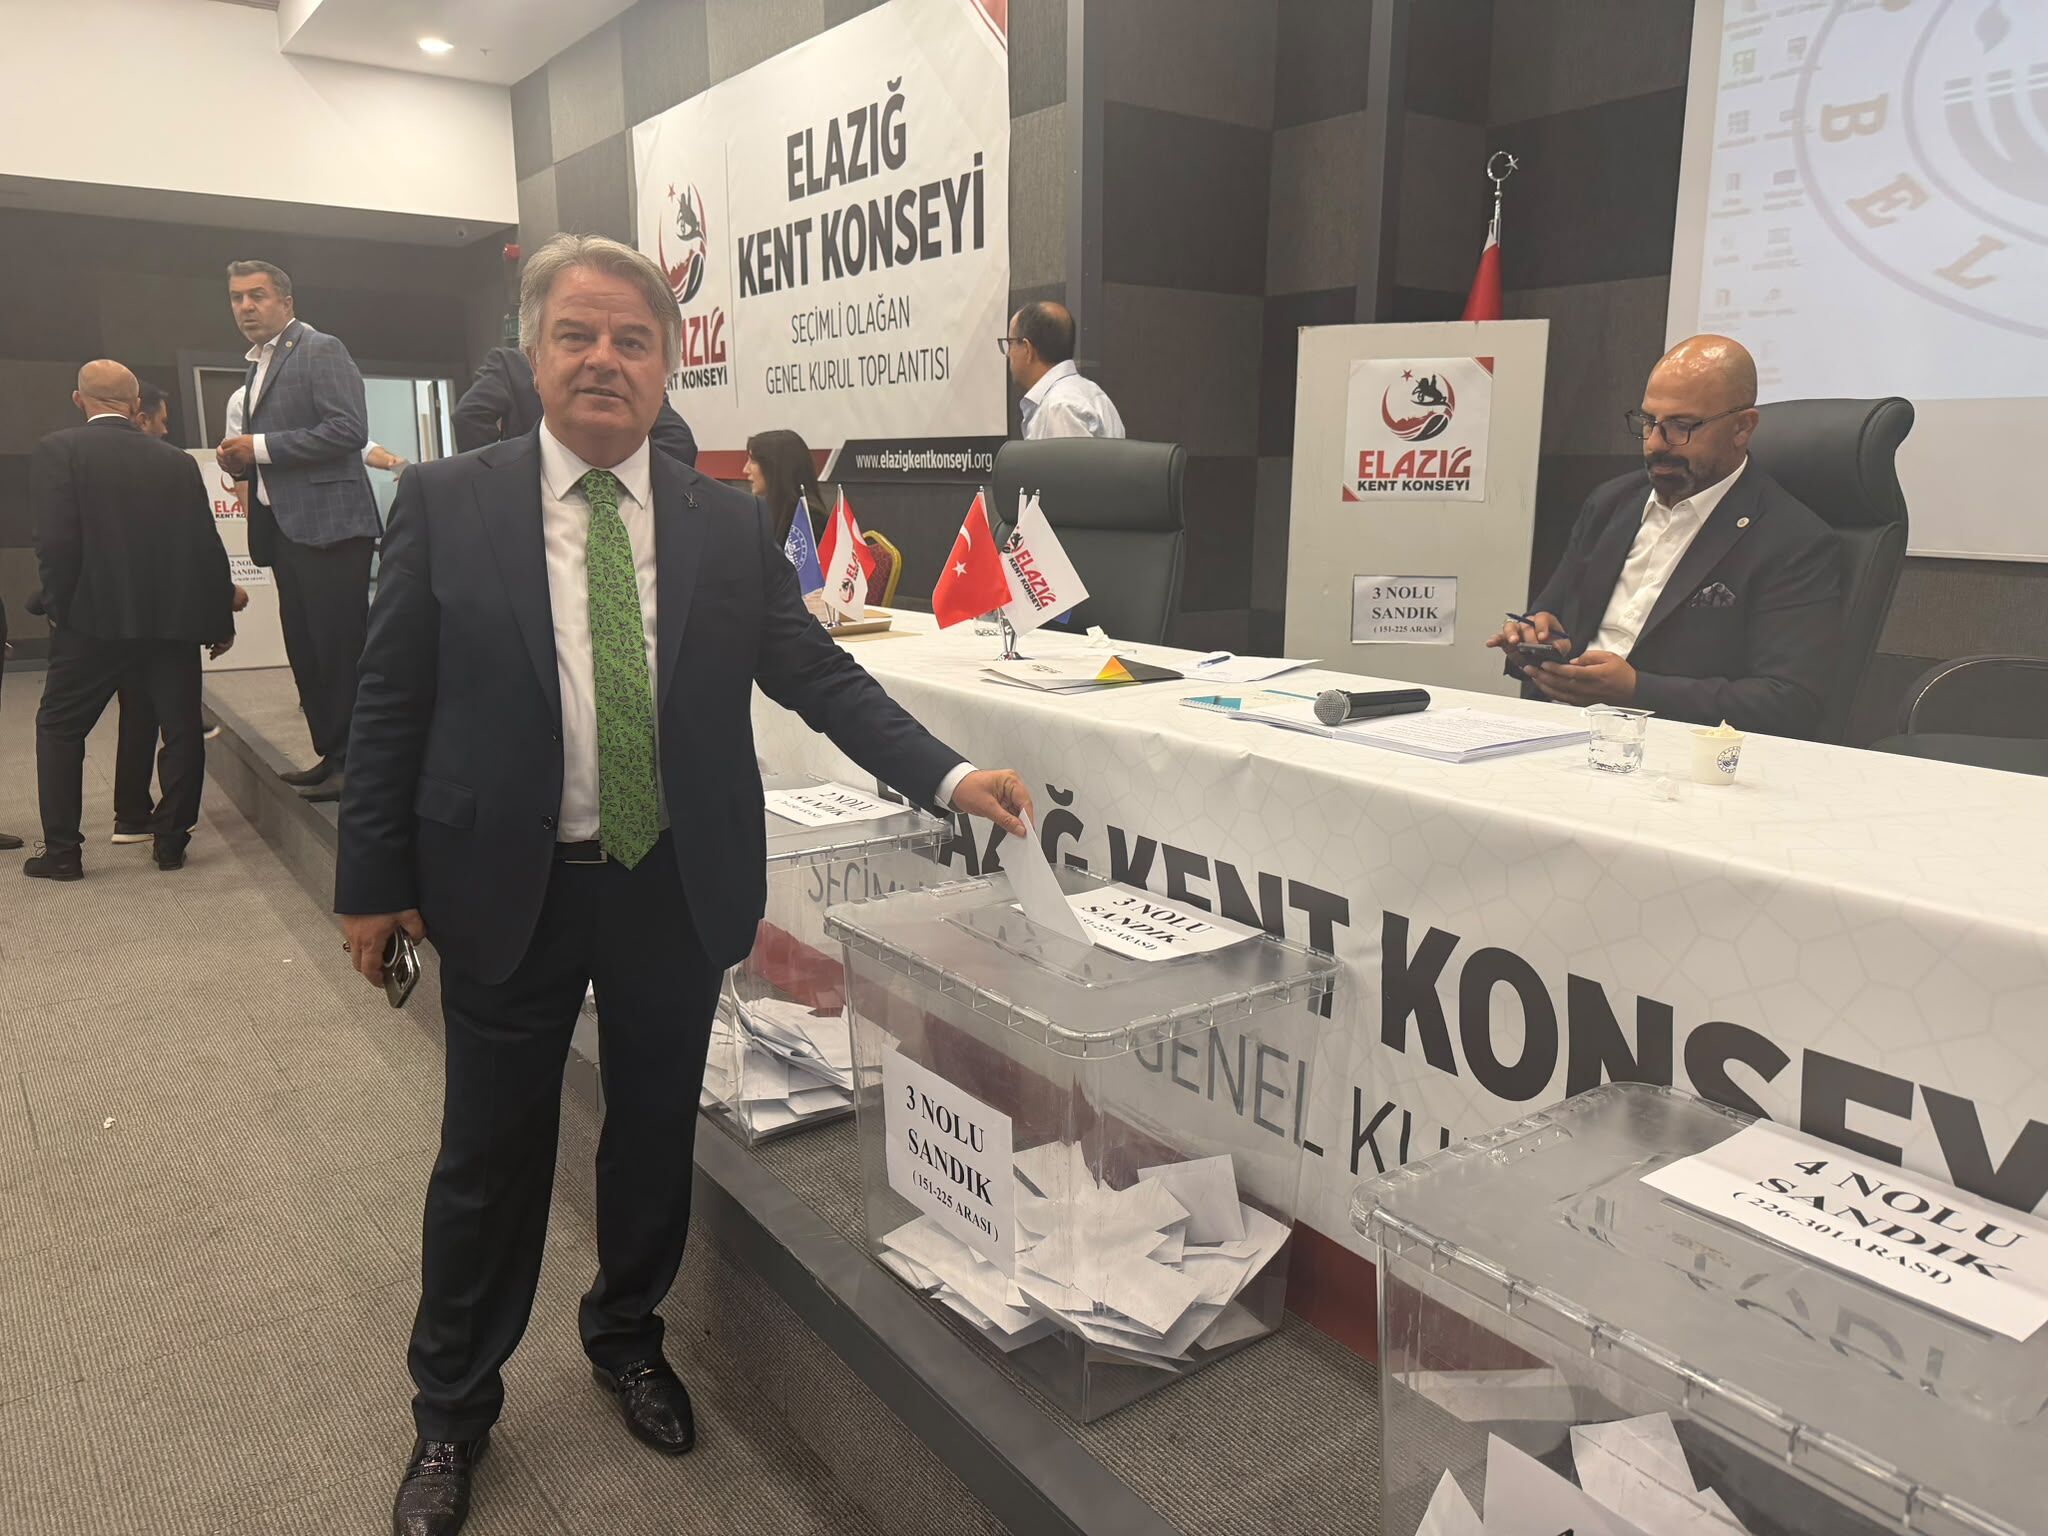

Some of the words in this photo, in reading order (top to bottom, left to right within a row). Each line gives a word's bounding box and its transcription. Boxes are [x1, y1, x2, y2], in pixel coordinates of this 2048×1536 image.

[786, 75, 907, 202] ELAZIĞ
[738, 217, 813, 298] KENT
[821, 151, 985, 281] KONSEYİ
[791, 302, 842, 346] SEÇİMLİ
[846, 293, 910, 336] OLAĞAN
[681, 365, 728, 390] KONSEYİ
[766, 364, 806, 394] GENEL
[809, 358, 854, 391] KURUL
[858, 346, 950, 387] TOPLANTISI
[855, 449, 993, 472] www.elazigkentkonseyi.org
[1358, 446, 1472, 479] ELAZIĞ
[1357, 480, 1395, 491] KENT
[1402, 479, 1470, 491] KONSEYİ
[1009, 557, 1024, 578] KENT
[1015, 549, 1056, 608] ELAZIĞ
[1372, 587, 1381, 599] 3
[1386, 586, 1435, 599] NOLU
[1372, 607, 1439, 620] SANDIK
[1082, 906, 1188, 944] SANDIK
[1112, 898, 1136, 906] 3
[1130, 903, 1215, 934] NOLU
[906, 1085, 916, 1111] 3
[920, 1092, 985, 1153] NOLU
[908, 1128, 994, 1206] SANDIK
[1794, 1160, 1829, 1176] 4
[1832, 1169, 2030, 1248] NOLU
[1755, 1178, 2015, 1280] SANDIK
